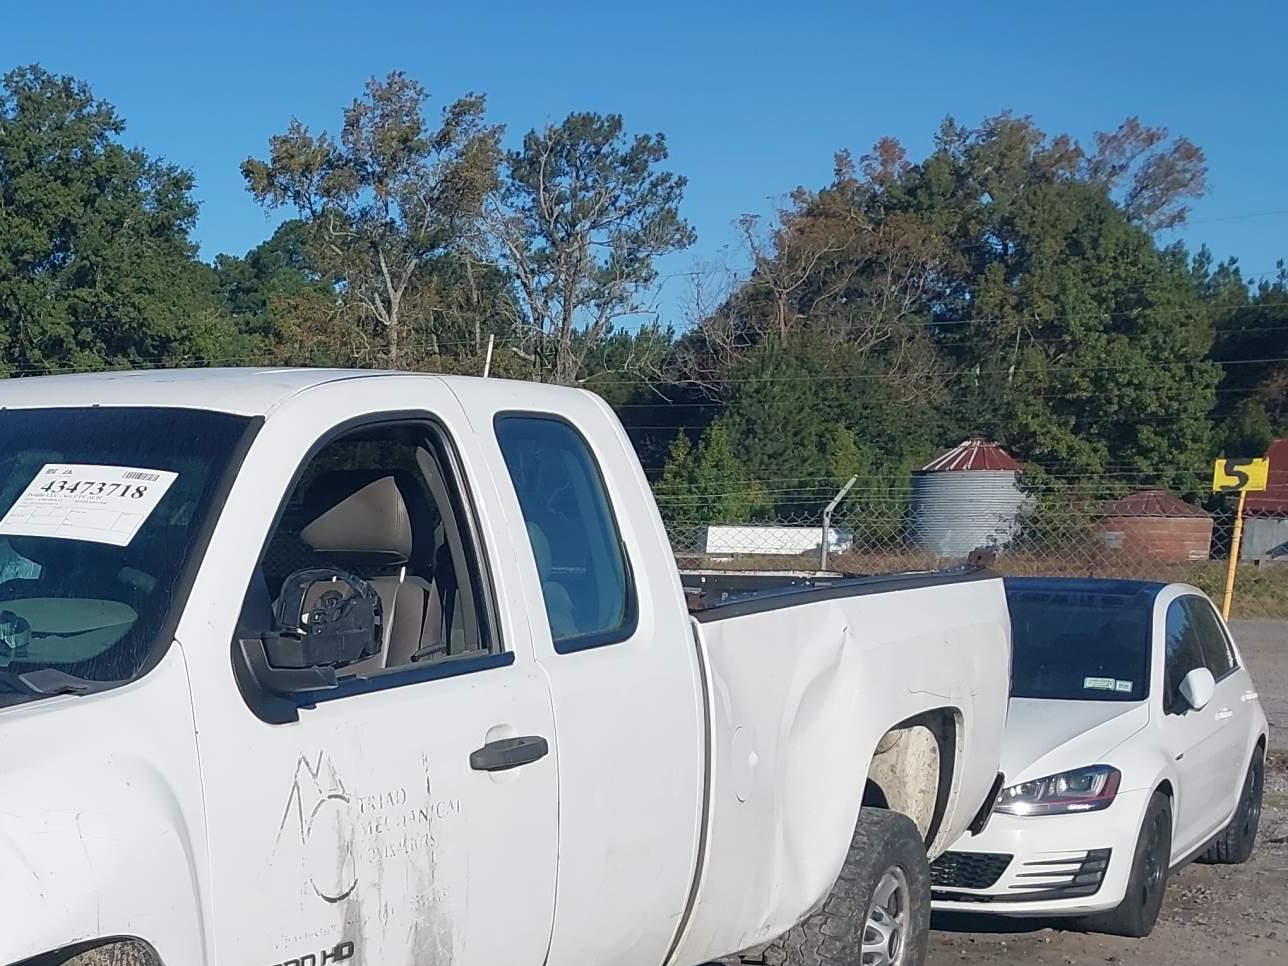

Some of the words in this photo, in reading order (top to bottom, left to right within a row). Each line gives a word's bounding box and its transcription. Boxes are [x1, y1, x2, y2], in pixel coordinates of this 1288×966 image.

[1220, 459, 1253, 490] 5
[40, 479, 148, 499] 43473718
[357, 787, 406, 814] TRIAD
[319, 941, 355, 966] HD
